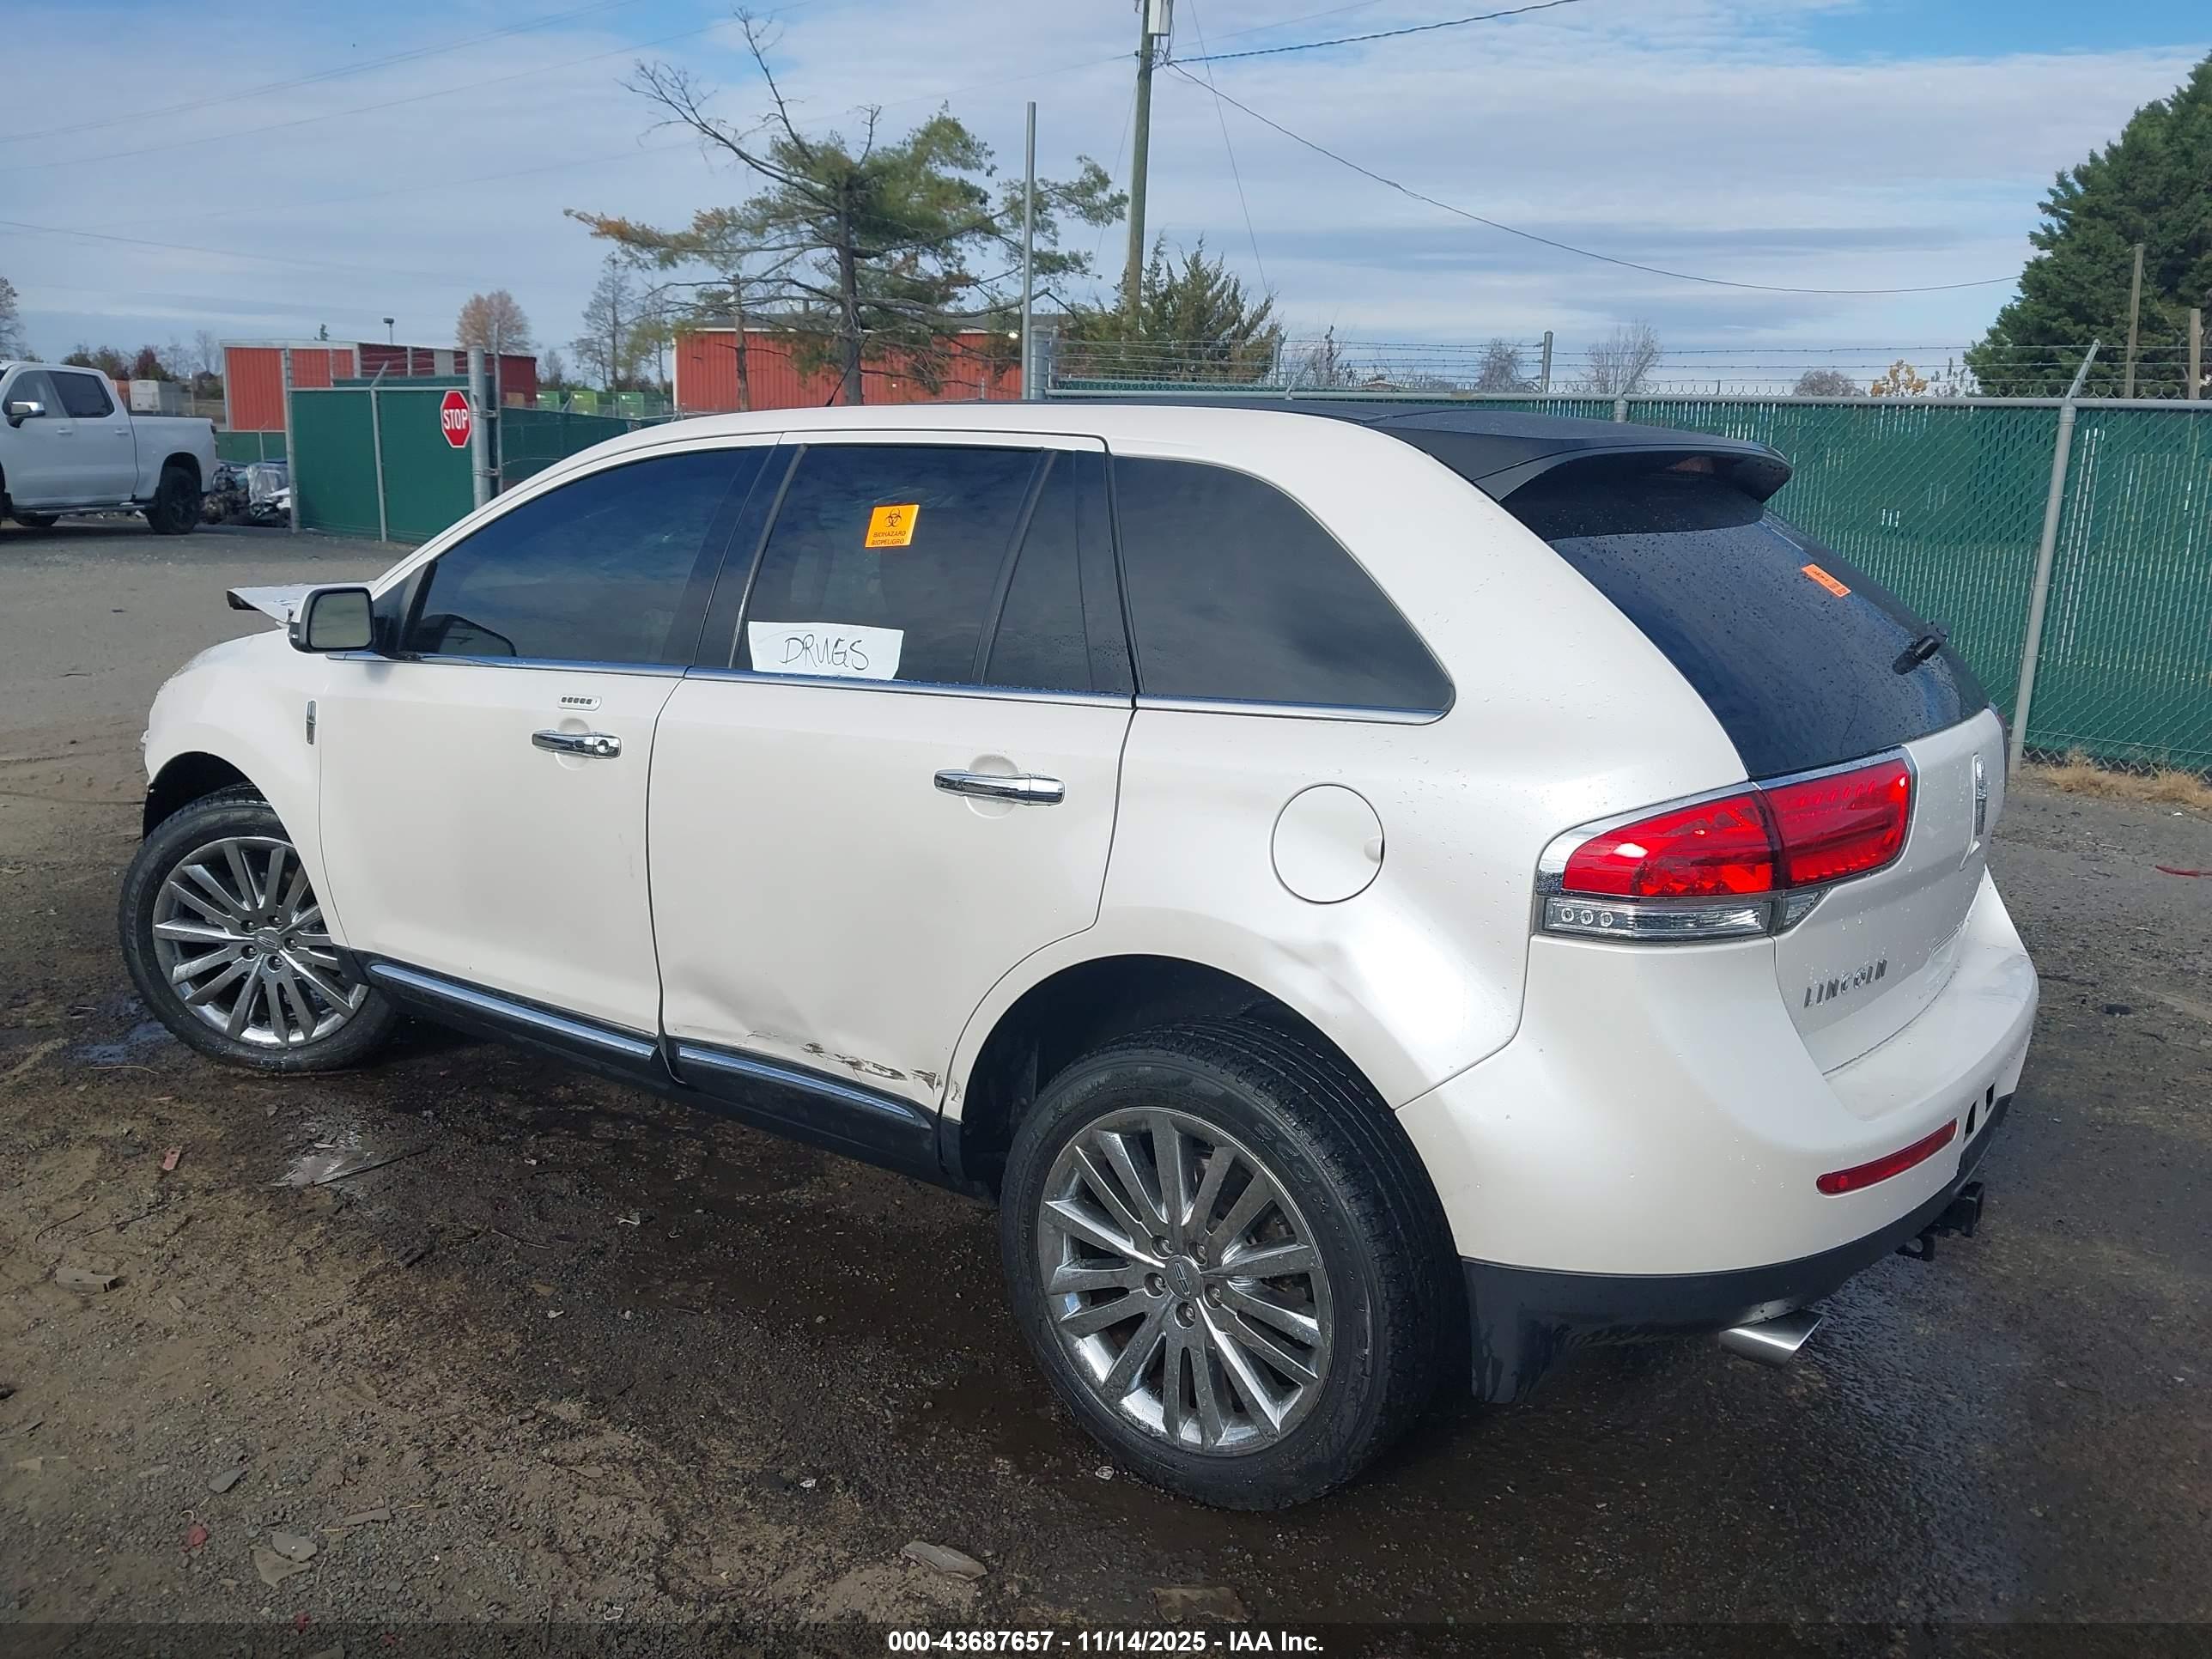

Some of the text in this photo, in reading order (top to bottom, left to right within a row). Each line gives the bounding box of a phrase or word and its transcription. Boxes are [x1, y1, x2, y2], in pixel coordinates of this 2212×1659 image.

[442, 408, 468, 430] STOP
[872, 530, 907, 538] BIOHAZARD
[780, 634, 870, 671] DRUGS
[1803, 958, 1888, 1008] LINCOLN
